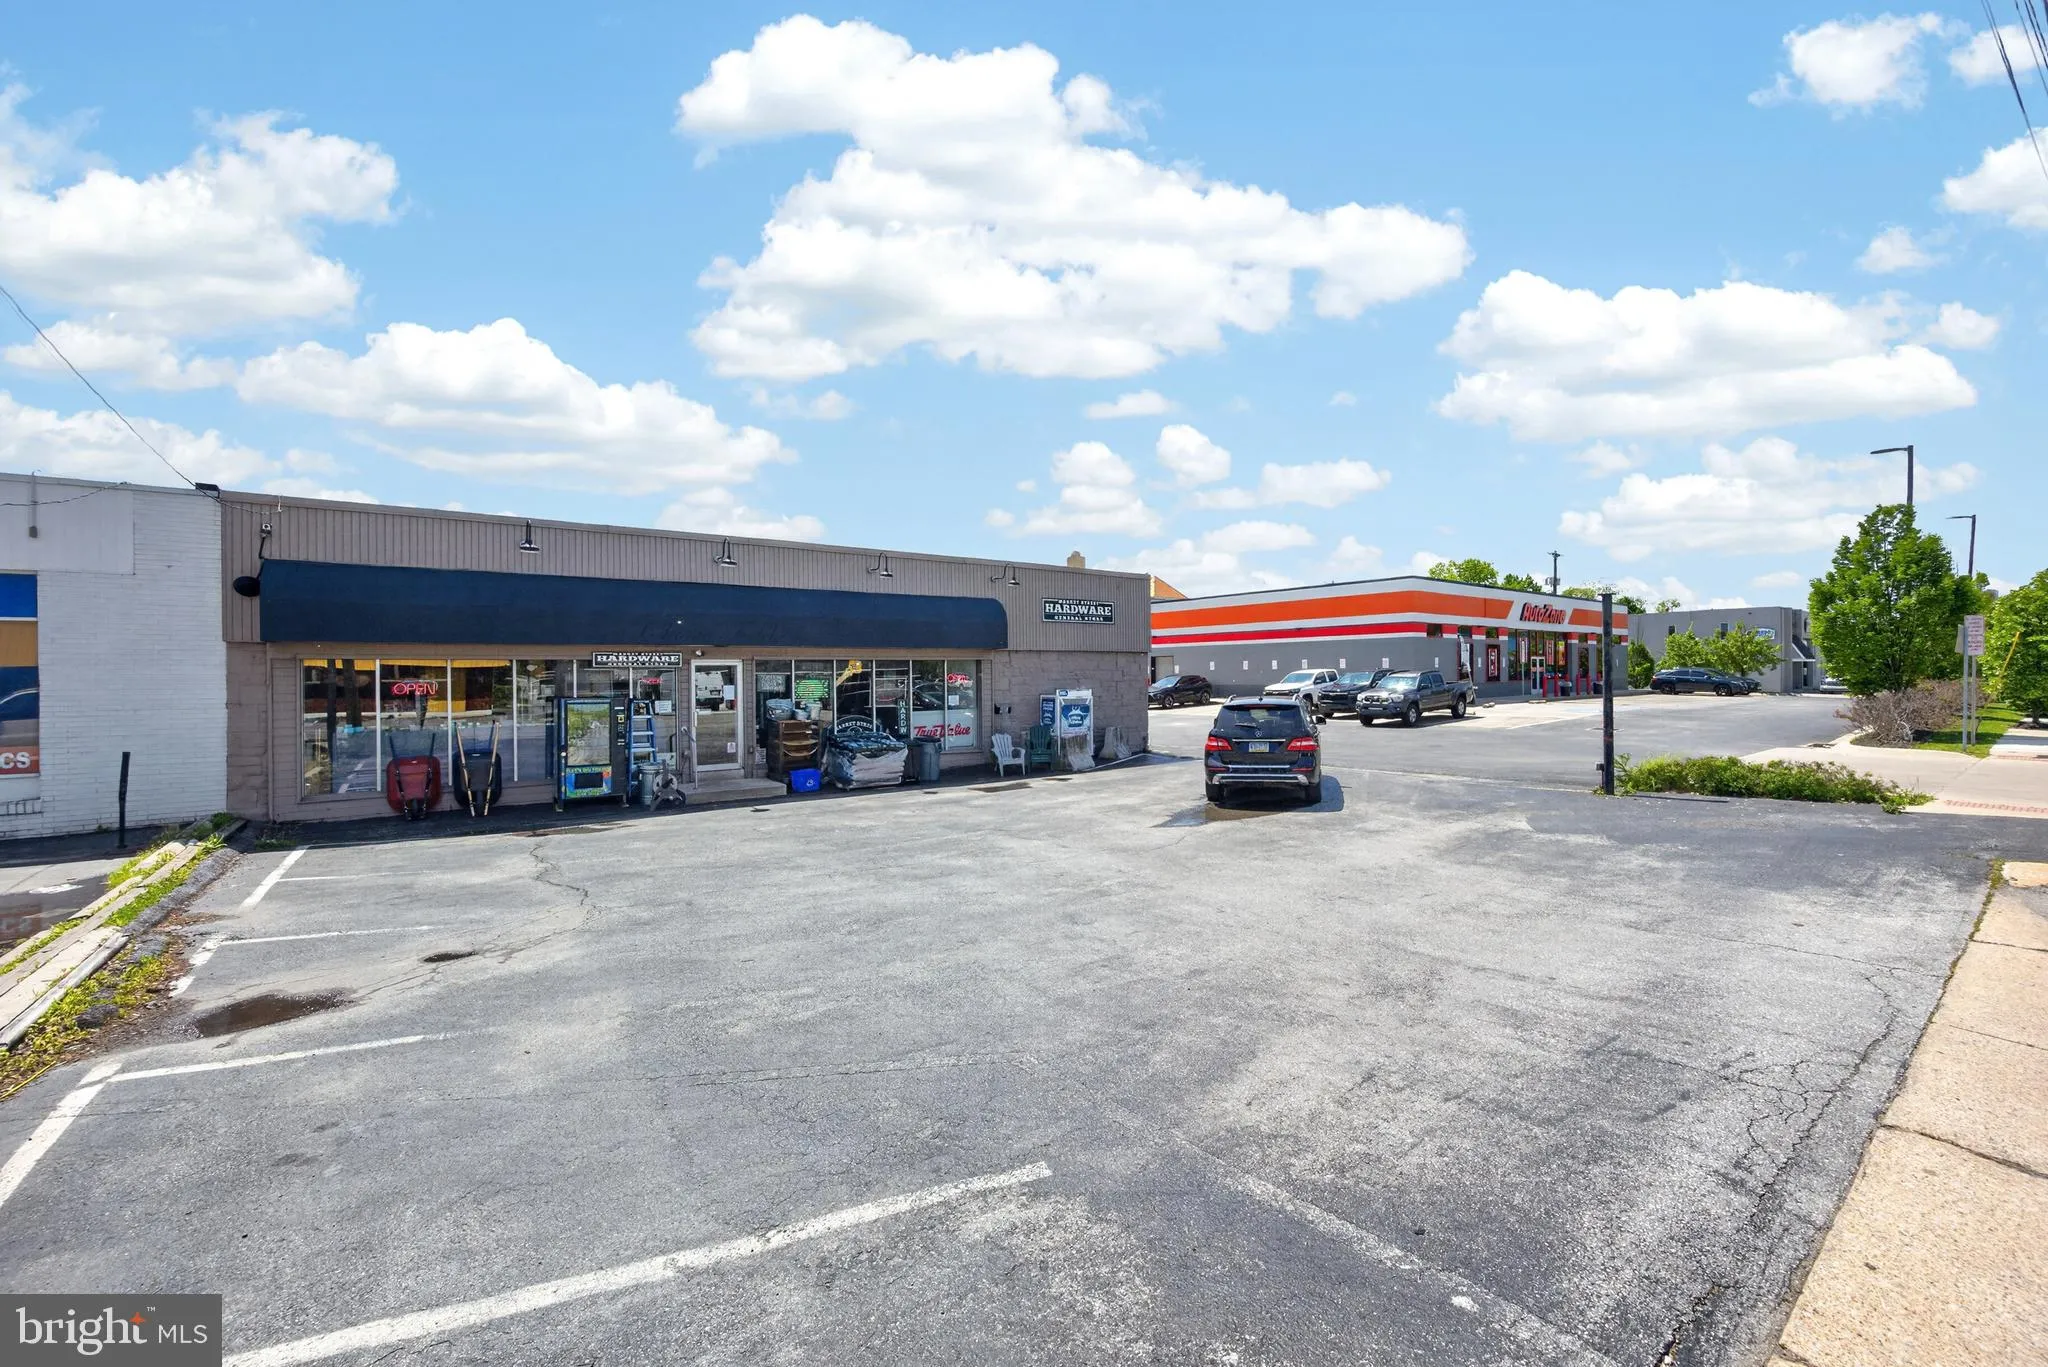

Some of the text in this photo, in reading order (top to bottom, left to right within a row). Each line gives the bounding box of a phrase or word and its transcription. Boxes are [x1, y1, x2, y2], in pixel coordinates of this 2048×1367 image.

[1045, 603, 1112, 616] HARDWARE
[1519, 602, 1566, 624] AutoZone
[392, 681, 437, 696] OPEN
[913, 722, 971, 738] True Value
